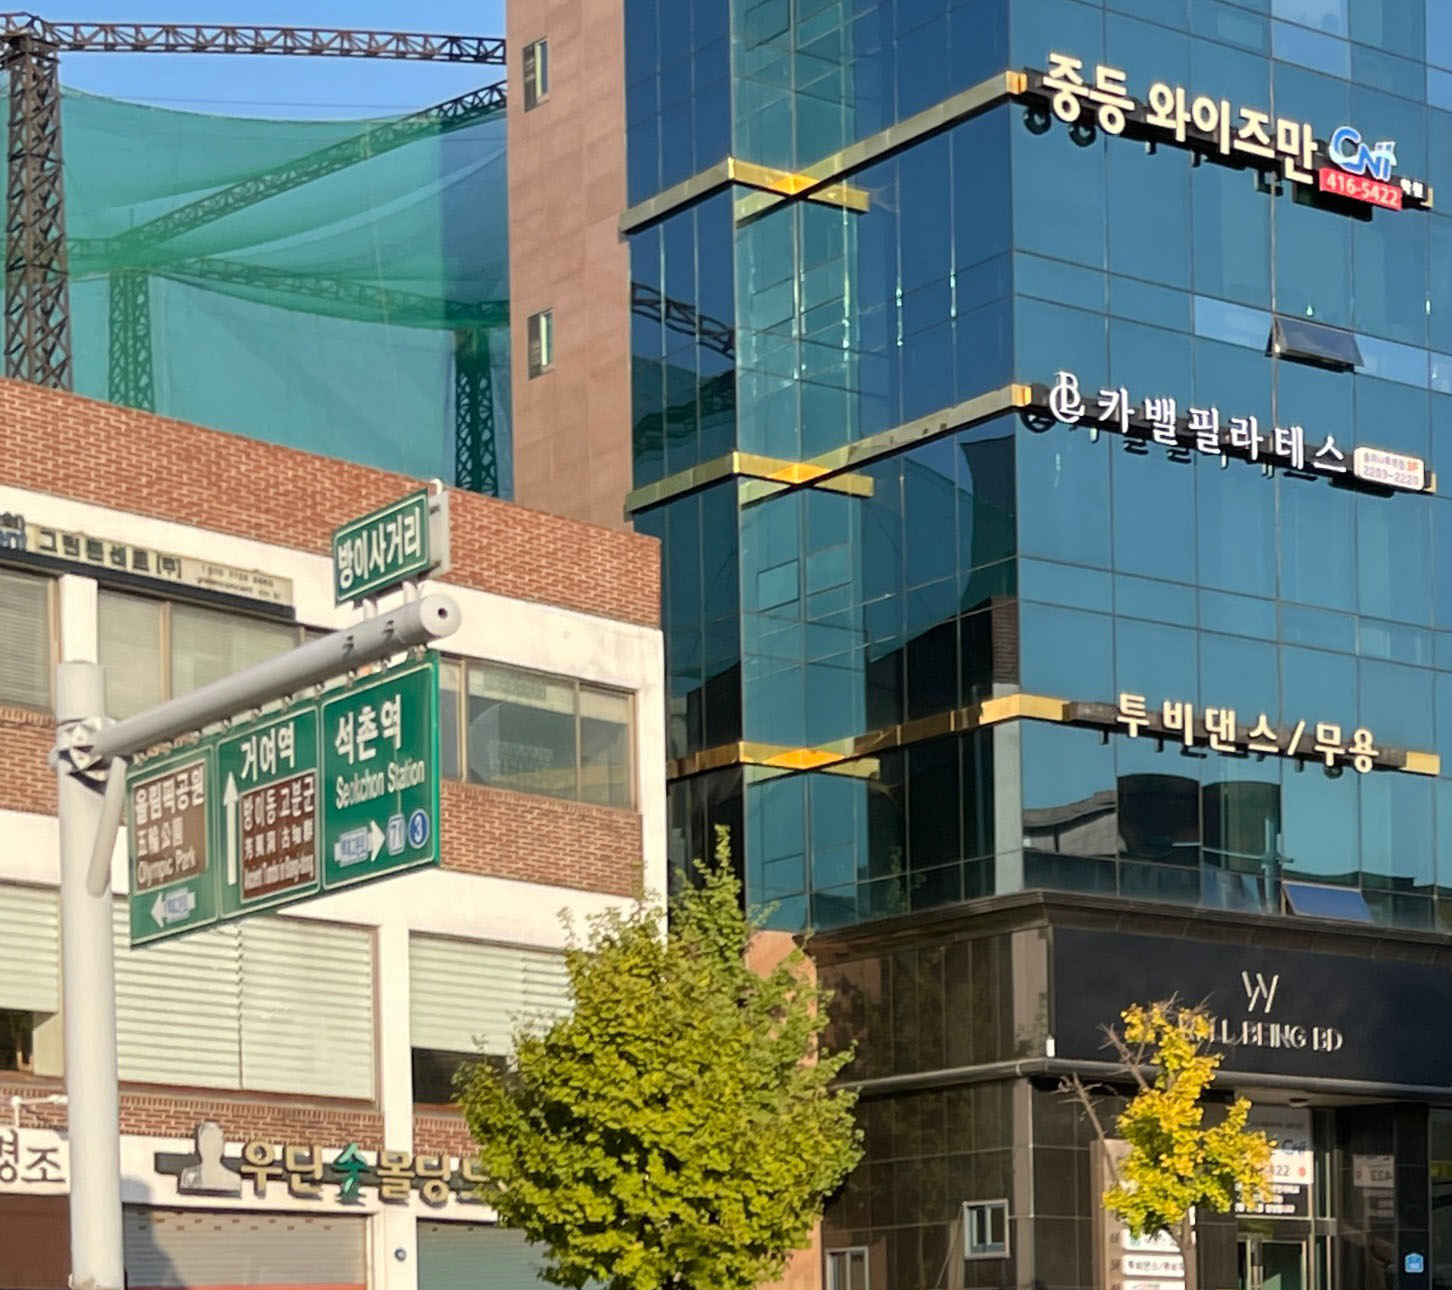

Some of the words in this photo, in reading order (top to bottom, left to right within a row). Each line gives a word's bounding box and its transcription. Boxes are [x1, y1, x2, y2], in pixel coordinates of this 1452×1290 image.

[1042, 51, 1135, 135] 중등
[1146, 82, 1318, 185] 와이즈만
[1325, 172, 1399, 207] 416-5422
[1098, 386, 1347, 473] 카밸필라테스
[338, 506, 421, 590] 방이사거리
[240, 721, 295, 782] 거여역
[334, 693, 402, 765] 석촌역
[1115, 692, 1380, 775] 투비댄스/무용
[135, 765, 204, 826] 올림픽공원
[243, 789, 278, 832] 방이동
[280, 775, 314, 818] 고분군
[336, 767, 385, 810] Seokchon
[387, 757, 425, 793] Station
[138, 857, 174, 887] Olympic
[175, 846, 197, 873] Park
[1242, 1020, 1307, 1049] BEING
